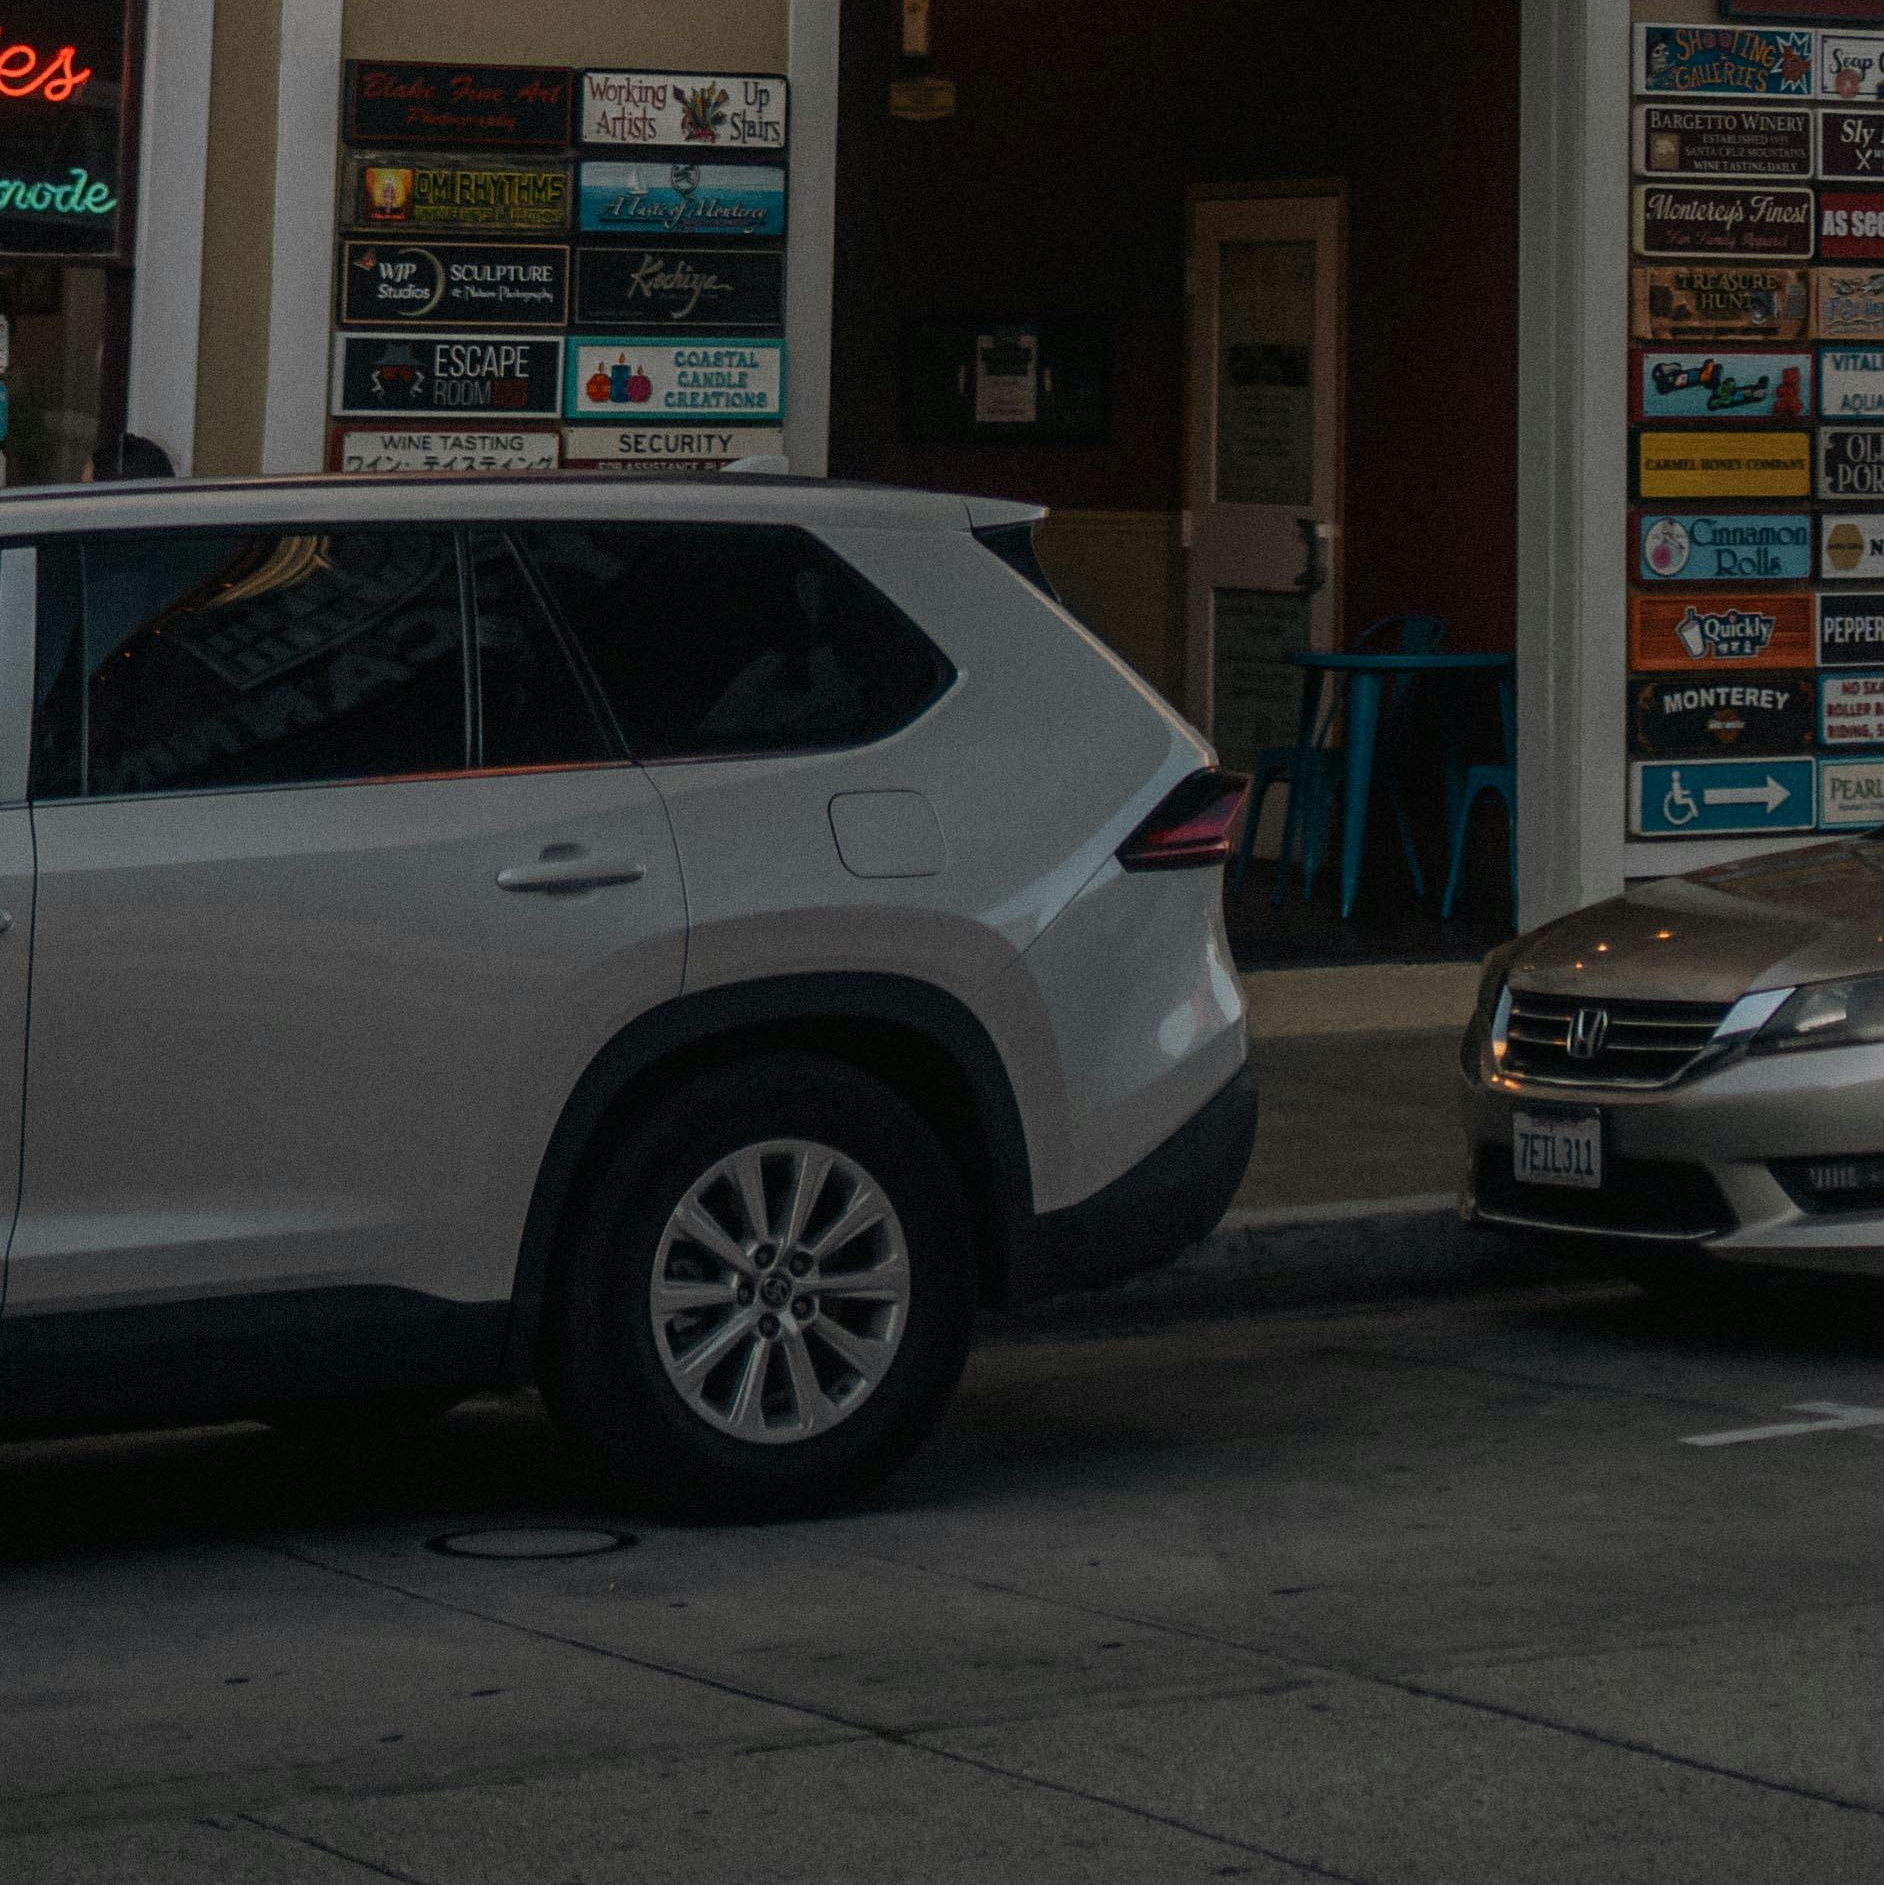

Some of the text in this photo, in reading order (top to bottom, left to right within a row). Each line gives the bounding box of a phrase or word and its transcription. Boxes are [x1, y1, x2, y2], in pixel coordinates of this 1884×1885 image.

[0, 43, 94, 103] es
[1674, 61, 1768, 93] GALLERIES
[1830, 47, 1874, 81] Soap
[585, 74, 667, 111] Working
[743, 81, 770, 114] Up
[596, 107, 657, 141] Artists
[730, 109, 781, 144] Stairs
[1651, 111, 1806, 131] BARGETTO WINERY
[1840, 118, 1875, 148] Sly
[1645, 192, 1809, 231] Monterey's Finest
[450, 264, 554, 282] SCULPTURE
[1678, 273, 1778, 291] TREASURE
[376, 283, 431, 300] Studios
[1701, 293, 1755, 310] HUNT
[433, 344, 530, 378] ESCAPE
[674, 351, 759, 368] COASTAL
[433, 379, 493, 406] ROOM
[678, 372, 748, 388] CANDLE
[664, 392, 768, 408] CREATIONS
[381, 435, 524, 451] WINE TASTING
[619, 433, 734, 454] SECURITY
[1690, 518, 1808, 546] Cinnamon
[1715, 547, 1783, 577] Rolls
[1703, 614, 1771, 642] Quickly
[1663, 686, 1790, 715] MONTEREY
[1842, 682, 1860, 695] NO
[1827, 702, 1871, 717] ROLLER
